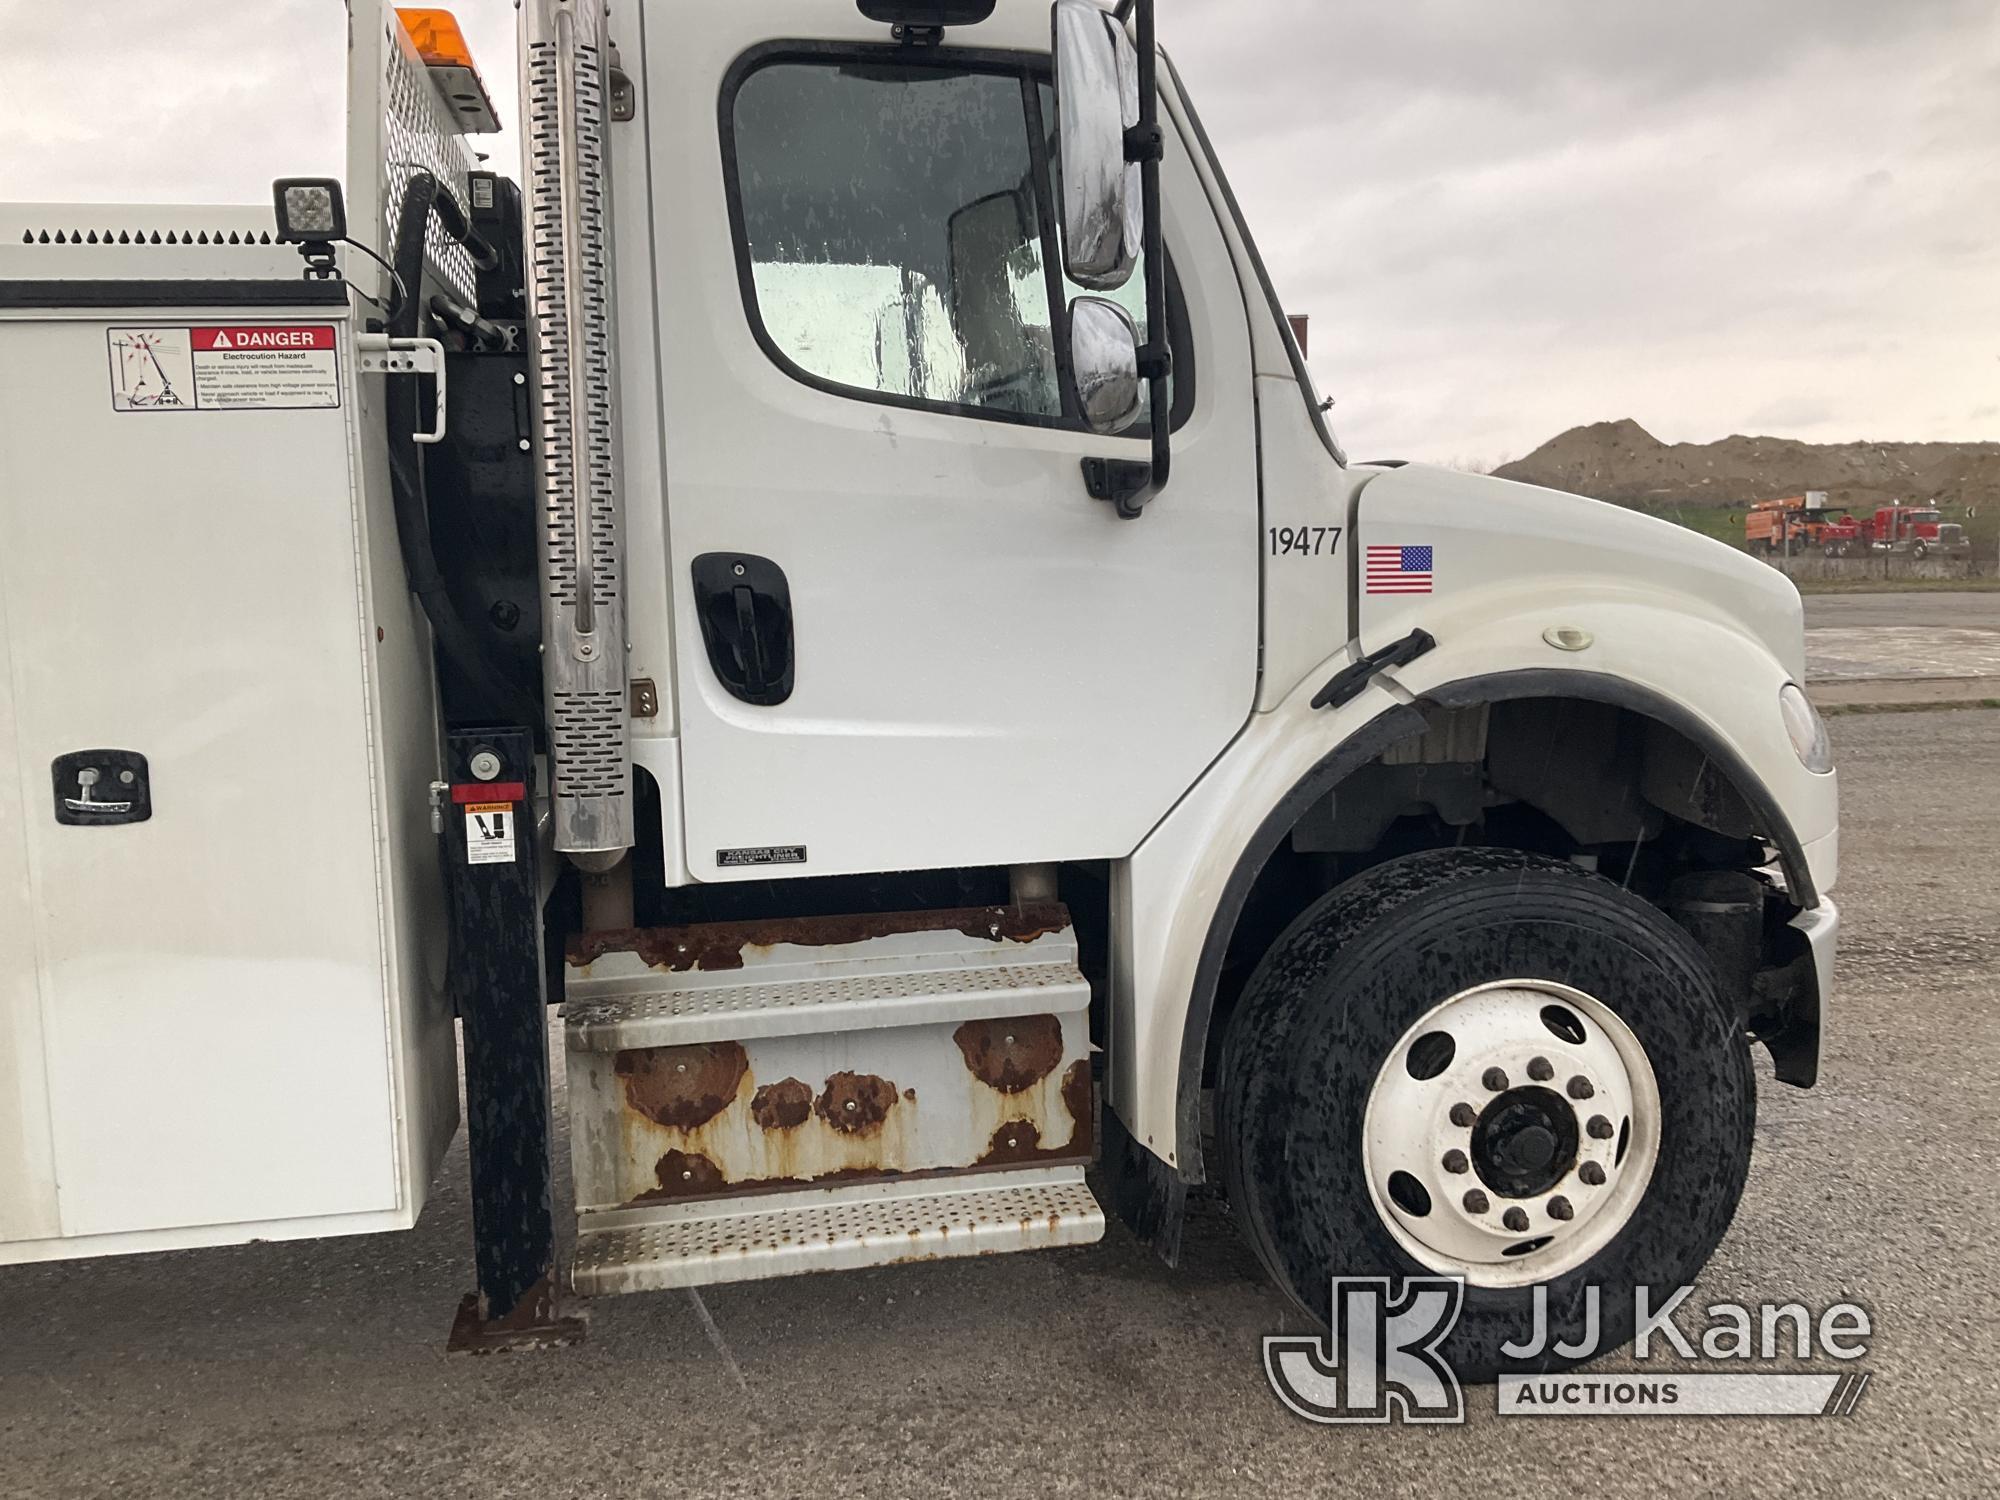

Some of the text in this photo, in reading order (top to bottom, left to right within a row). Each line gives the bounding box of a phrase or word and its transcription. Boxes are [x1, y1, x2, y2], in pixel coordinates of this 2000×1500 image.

[236, 332, 314, 346] DANGER
[278, 352, 306, 360] Hazard
[1269, 526, 1342, 556] 19477
